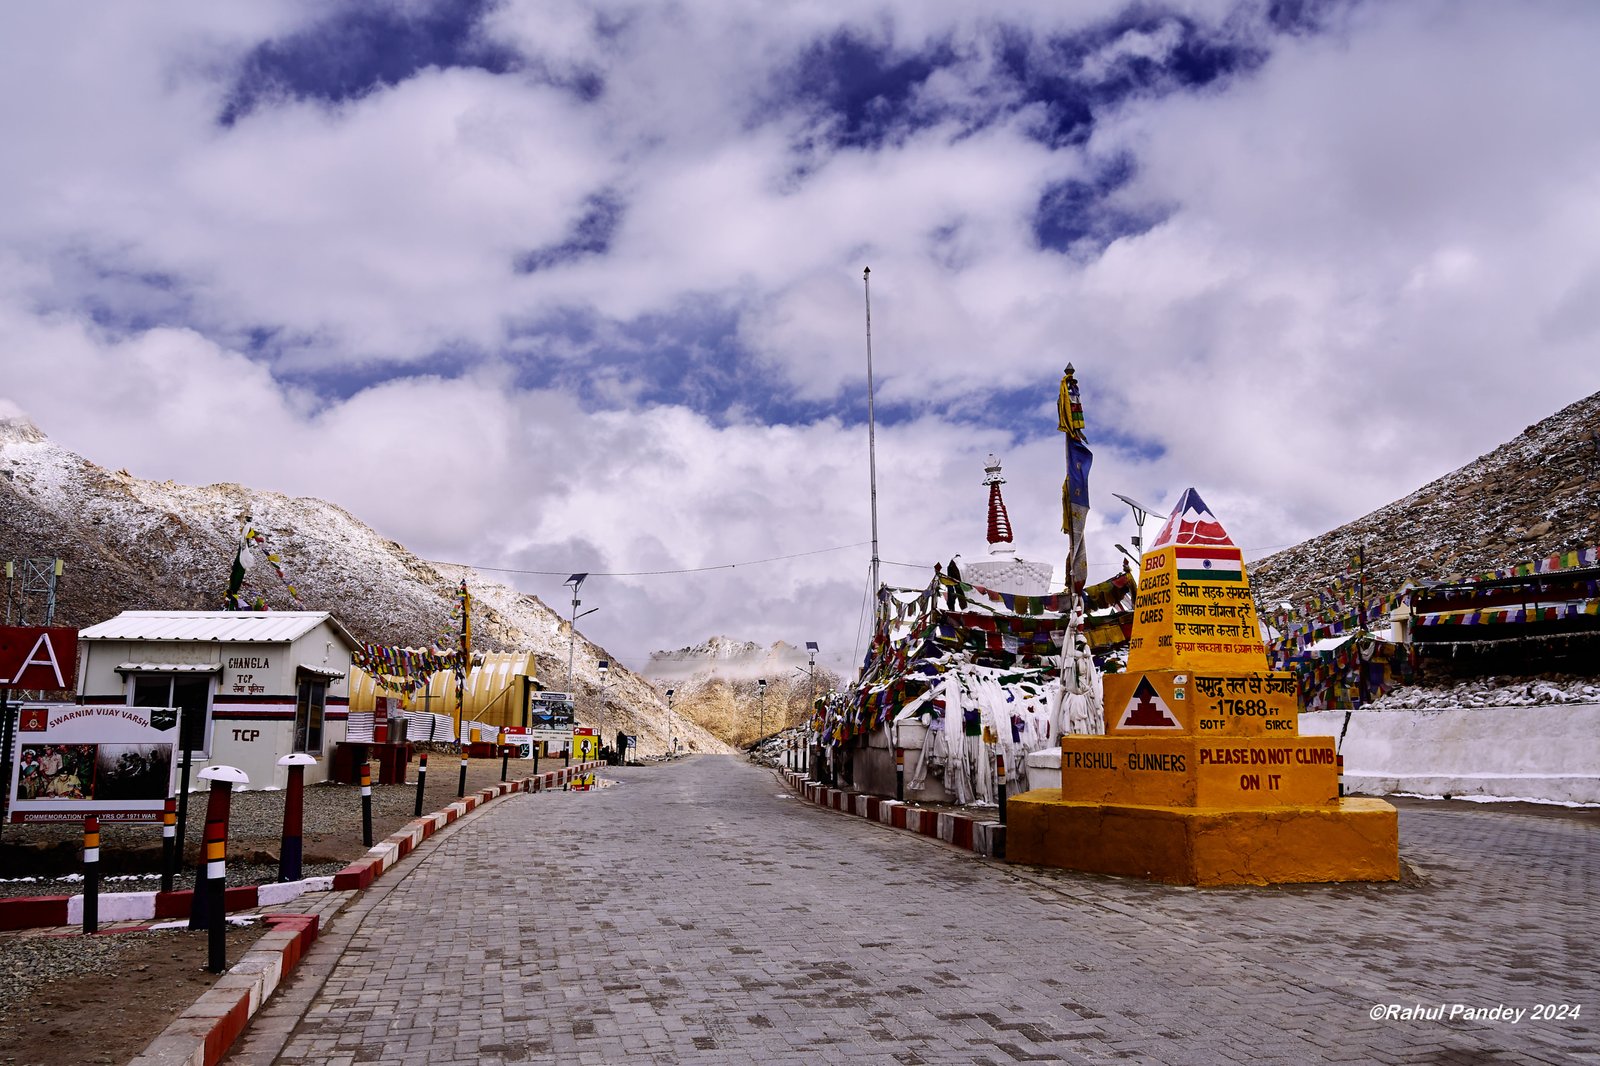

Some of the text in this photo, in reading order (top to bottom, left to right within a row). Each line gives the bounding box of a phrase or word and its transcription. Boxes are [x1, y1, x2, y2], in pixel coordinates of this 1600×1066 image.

[1145, 554, 1165, 571] BRO
[1140, 573, 1170, 591] CREATES
[1136, 589, 1171, 608] CONNECTS
[1175, 582, 1251, 600] सीमा सड़क संगठन
[1140, 608, 1163, 624] CARES
[1175, 604, 1206, 617] आपका
[1174, 623, 1186, 636] पर
[1188, 623, 1215, 636] स्वागत
[1216, 624, 1240, 637] करता
[1175, 642, 1196, 655] कृपया
[1223, 643, 1232, 653] का
[228, 658, 270, 669] CHANGLA
[237, 674, 253, 683] TCP
[1226, 677, 1248, 694] तल
[1248, 672, 1263, 694] से
[49, 708, 149, 728] SWARNIM VIJAY VARSH
[1269, 708, 1279, 716] FT
[1200, 720, 1225, 730] 50TF
[1265, 720, 1293, 730] 51RCC
[232, 729, 260, 742] TCP
[1064, 752, 1186, 772] TRISHUL GUNNERS
[1200, 748, 1334, 765] PLEASE DO NOT CLIMB
[1240, 774, 1281, 791] ON IT
